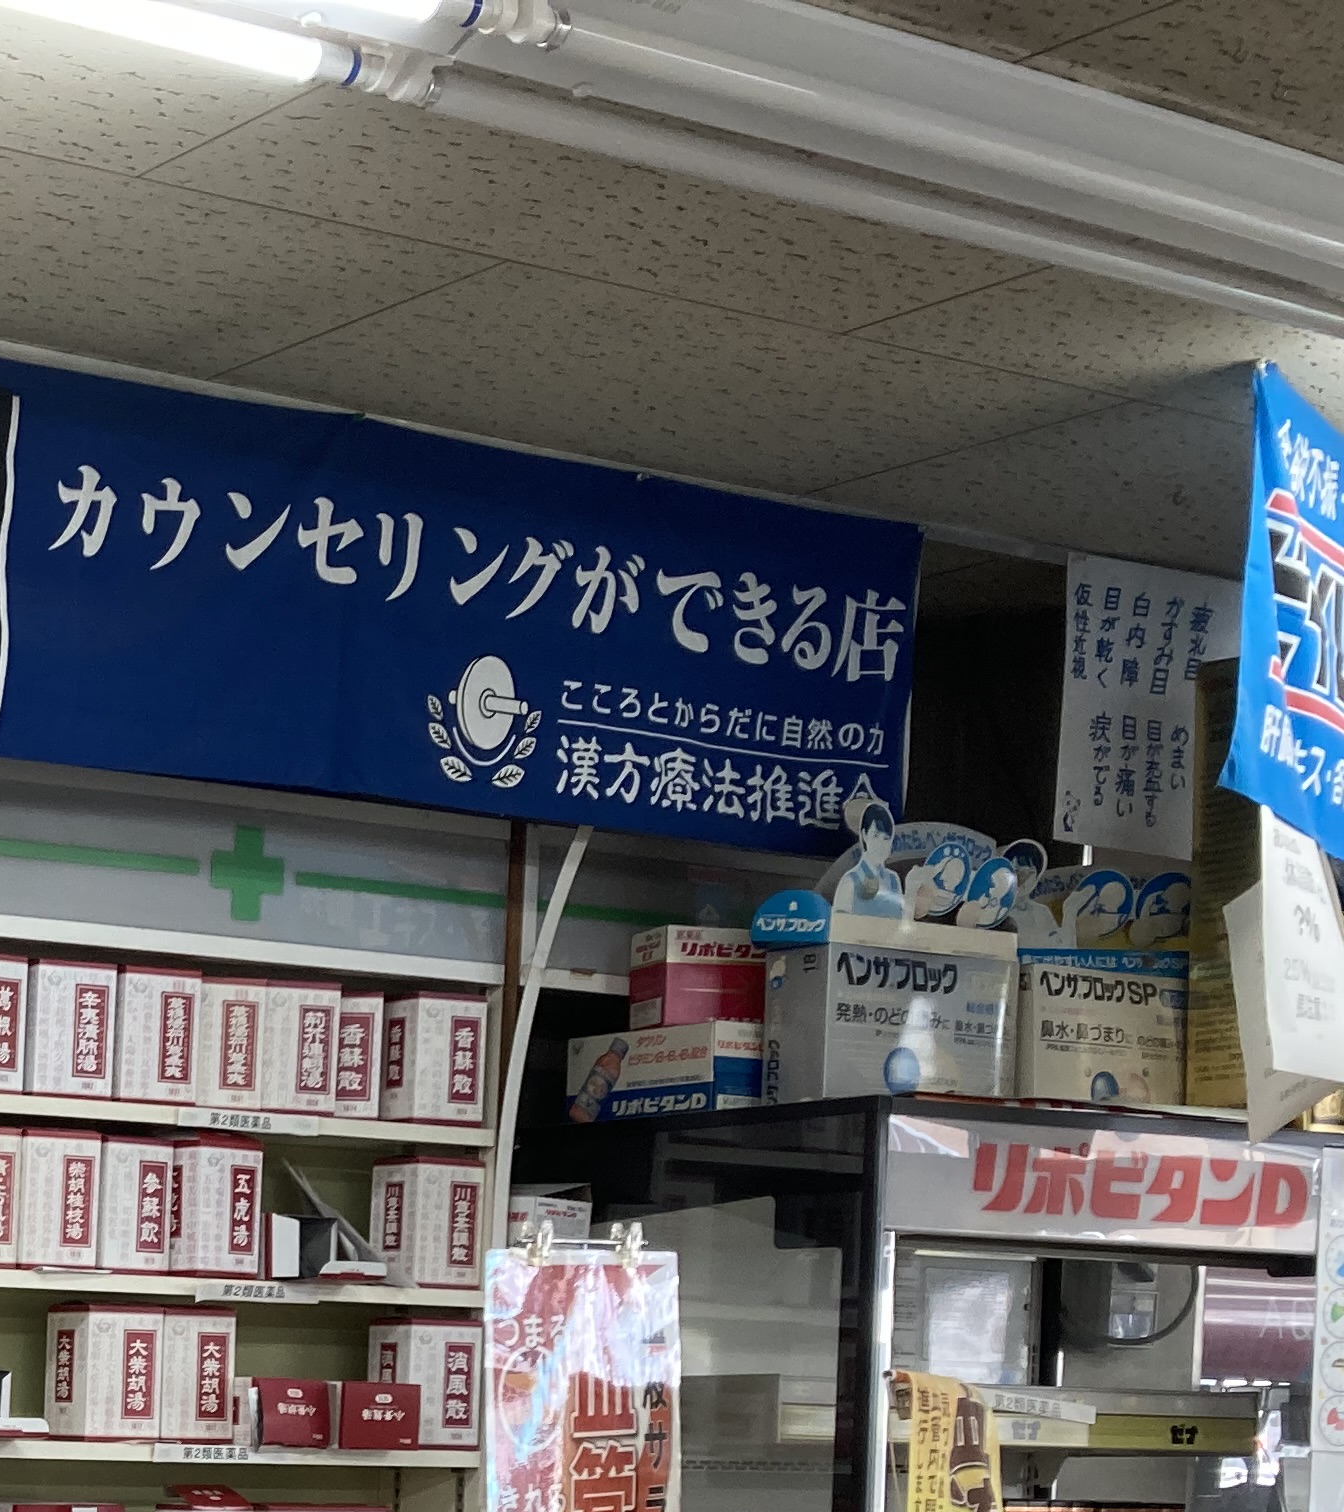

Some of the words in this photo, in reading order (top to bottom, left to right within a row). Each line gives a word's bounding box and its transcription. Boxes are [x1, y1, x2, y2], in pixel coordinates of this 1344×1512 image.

[48, 463, 907, 685] カウンセリングができる店
[1120, 592, 1150, 688] 白内障
[1151, 596, 1184, 695] かすみ目
[559, 677, 887, 758] こころとからだに自然の力
[1170, 723, 1189, 791] めまい
[1114, 715, 1138, 818] 目が痛い
[209, 1112, 273, 1131] 第2類医薬品
[612, 1090, 707, 1117] リポビタンD
[971, 1141, 1310, 1231] リポビタンD
[182, 1445, 250, 1461] 第2類医薬品
